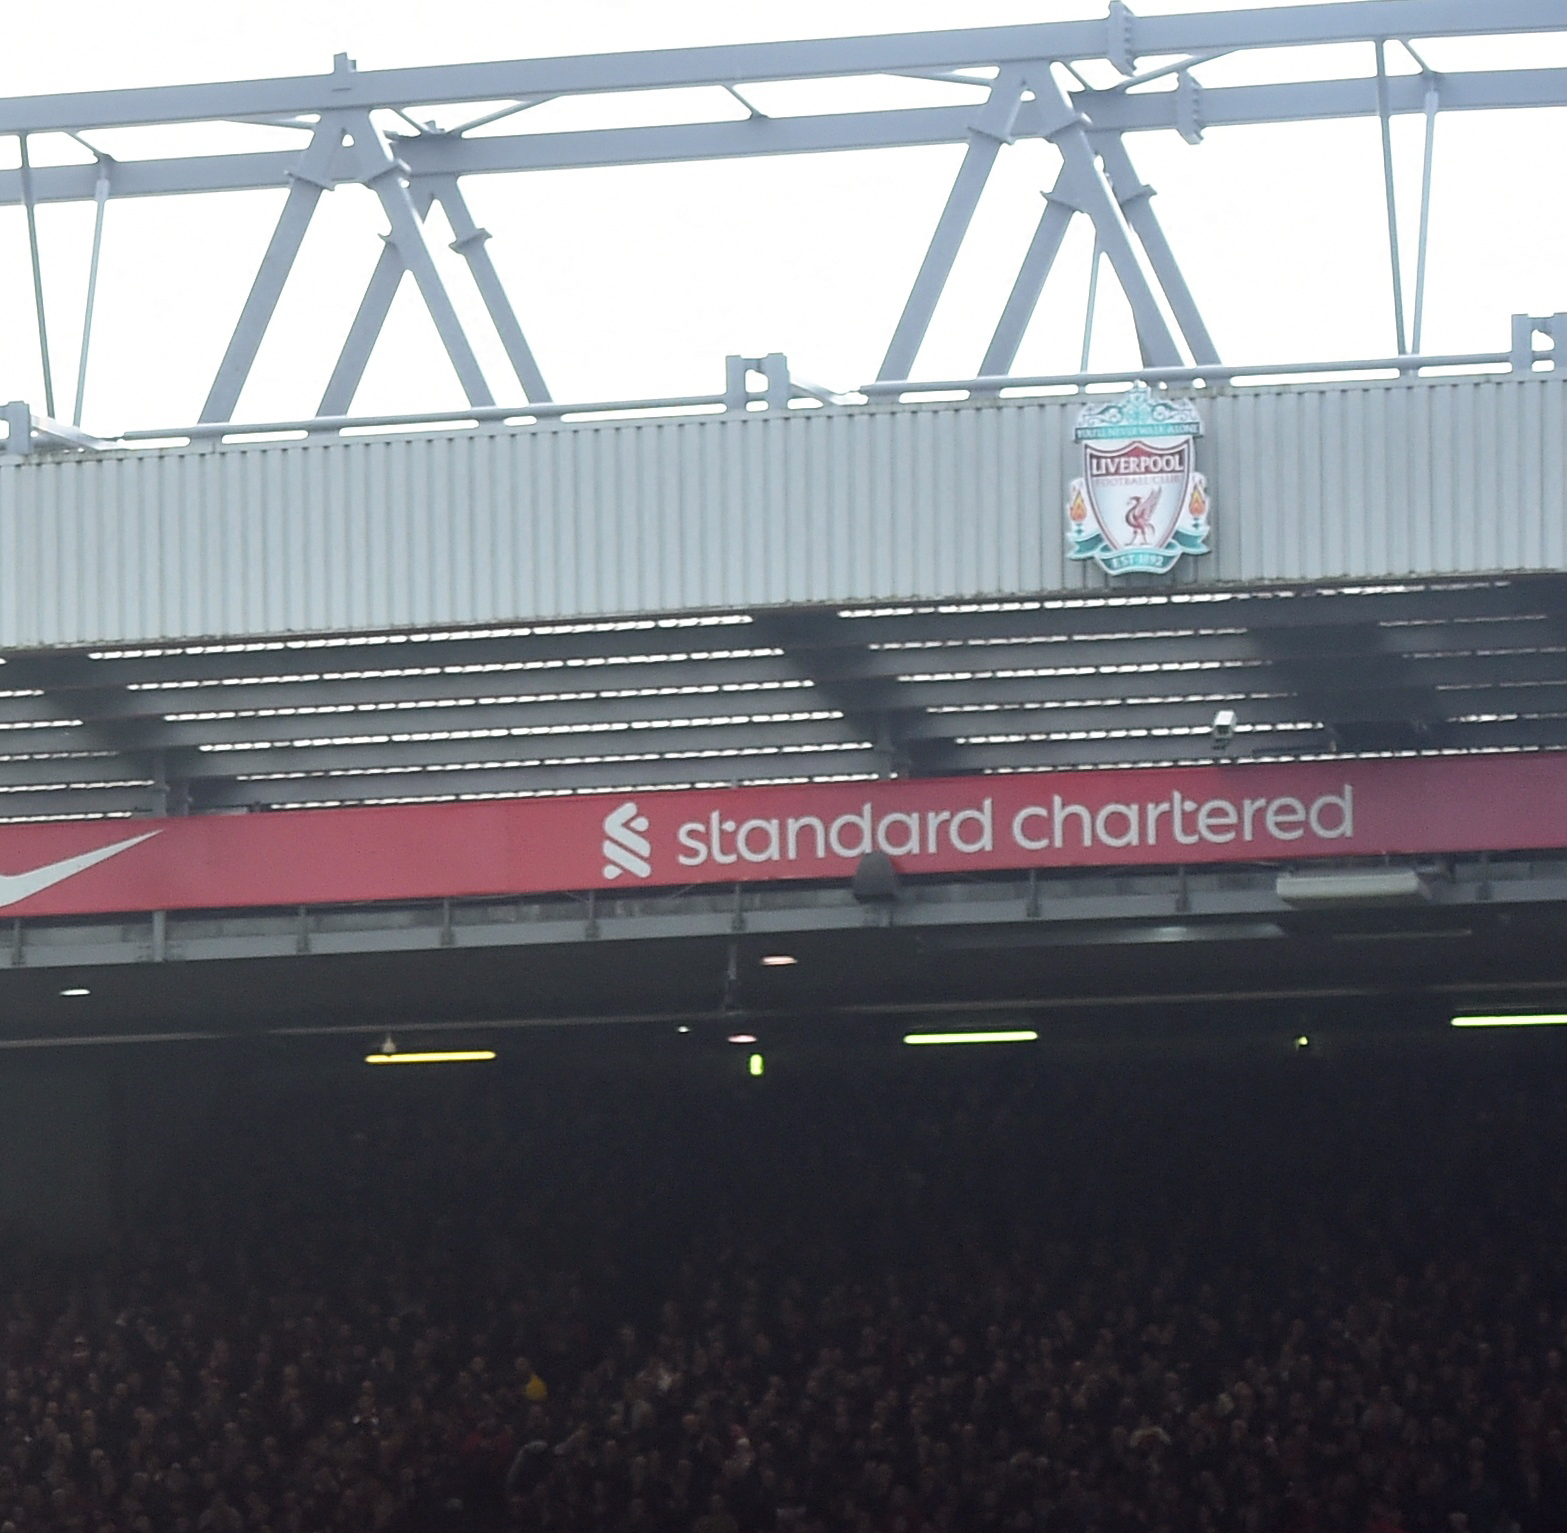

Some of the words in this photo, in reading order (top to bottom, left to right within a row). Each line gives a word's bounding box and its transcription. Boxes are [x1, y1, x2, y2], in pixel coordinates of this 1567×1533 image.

[1091, 455, 1184, 475] LIVERPOOL
[677, 798, 993, 866] standard
[1012, 784, 1355, 851] chartered
